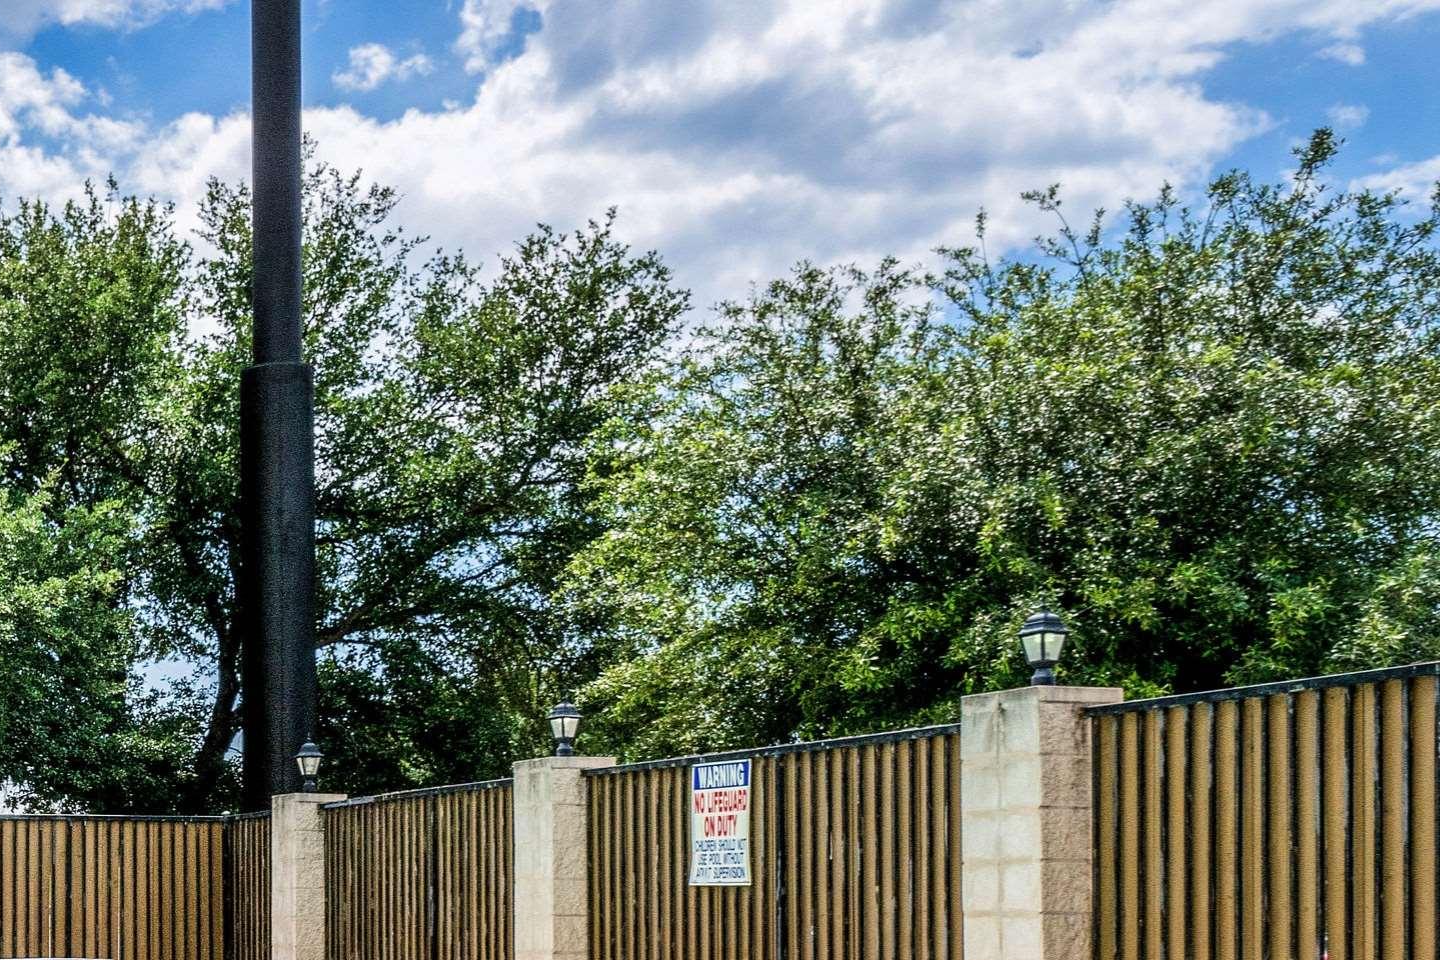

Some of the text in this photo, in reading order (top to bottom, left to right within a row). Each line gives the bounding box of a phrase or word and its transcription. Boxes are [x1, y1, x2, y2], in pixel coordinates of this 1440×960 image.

[698, 763, 745, 789] WARNING
[694, 789, 747, 814] NO LIFEGUARD
[704, 814, 738, 837] ON DUTY
